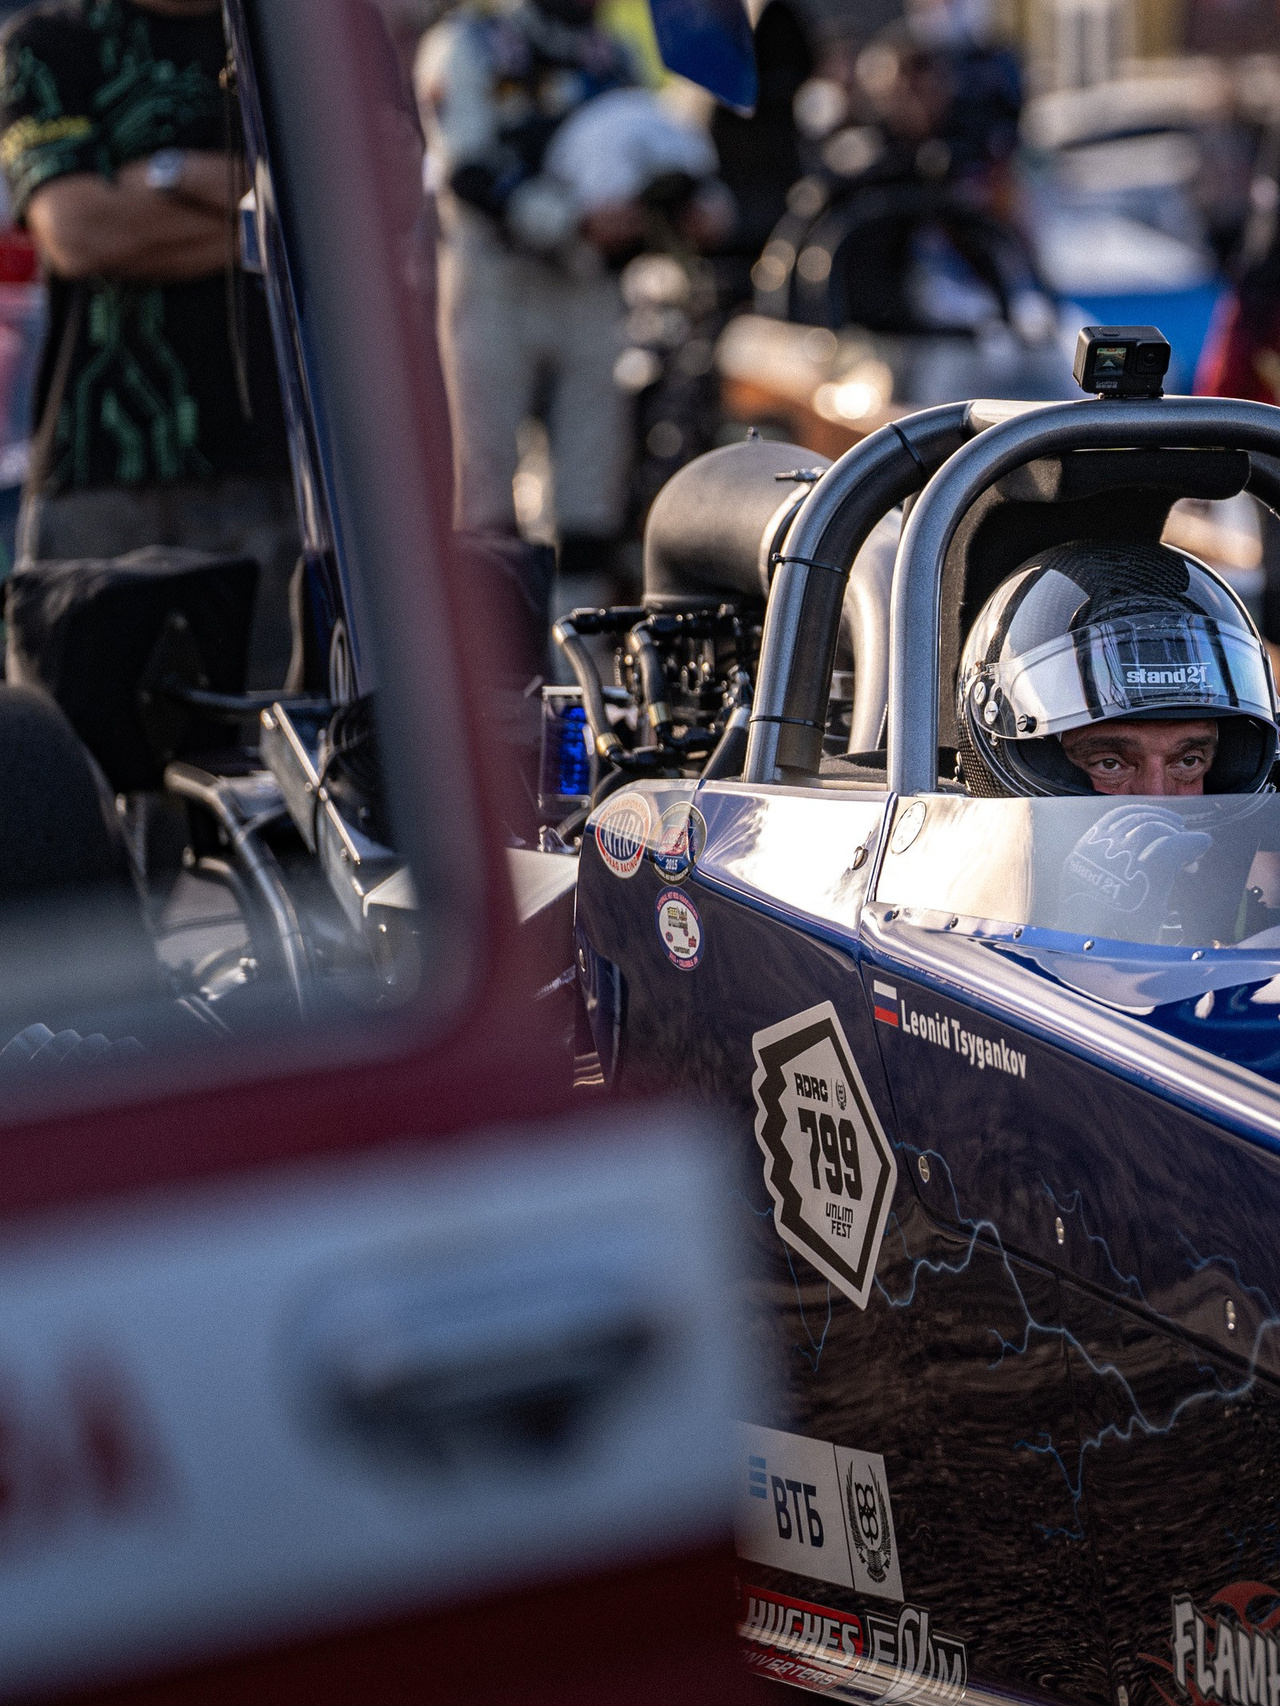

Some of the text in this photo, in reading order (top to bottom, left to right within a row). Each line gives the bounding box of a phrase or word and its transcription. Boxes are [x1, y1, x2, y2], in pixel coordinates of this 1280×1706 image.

[604, 812, 641, 858] NHRA
[900, 999, 1027, 1079] Leonid Tsygankov
[794, 1072, 829, 1103] RDRC
[797, 1107, 863, 1201] 799
[825, 1202, 854, 1224] UNLIM
[831, 1220, 852, 1239] FEST
[770, 1475, 825, 1548] ВТБ
[743, 1597, 860, 1668] HUGHES
